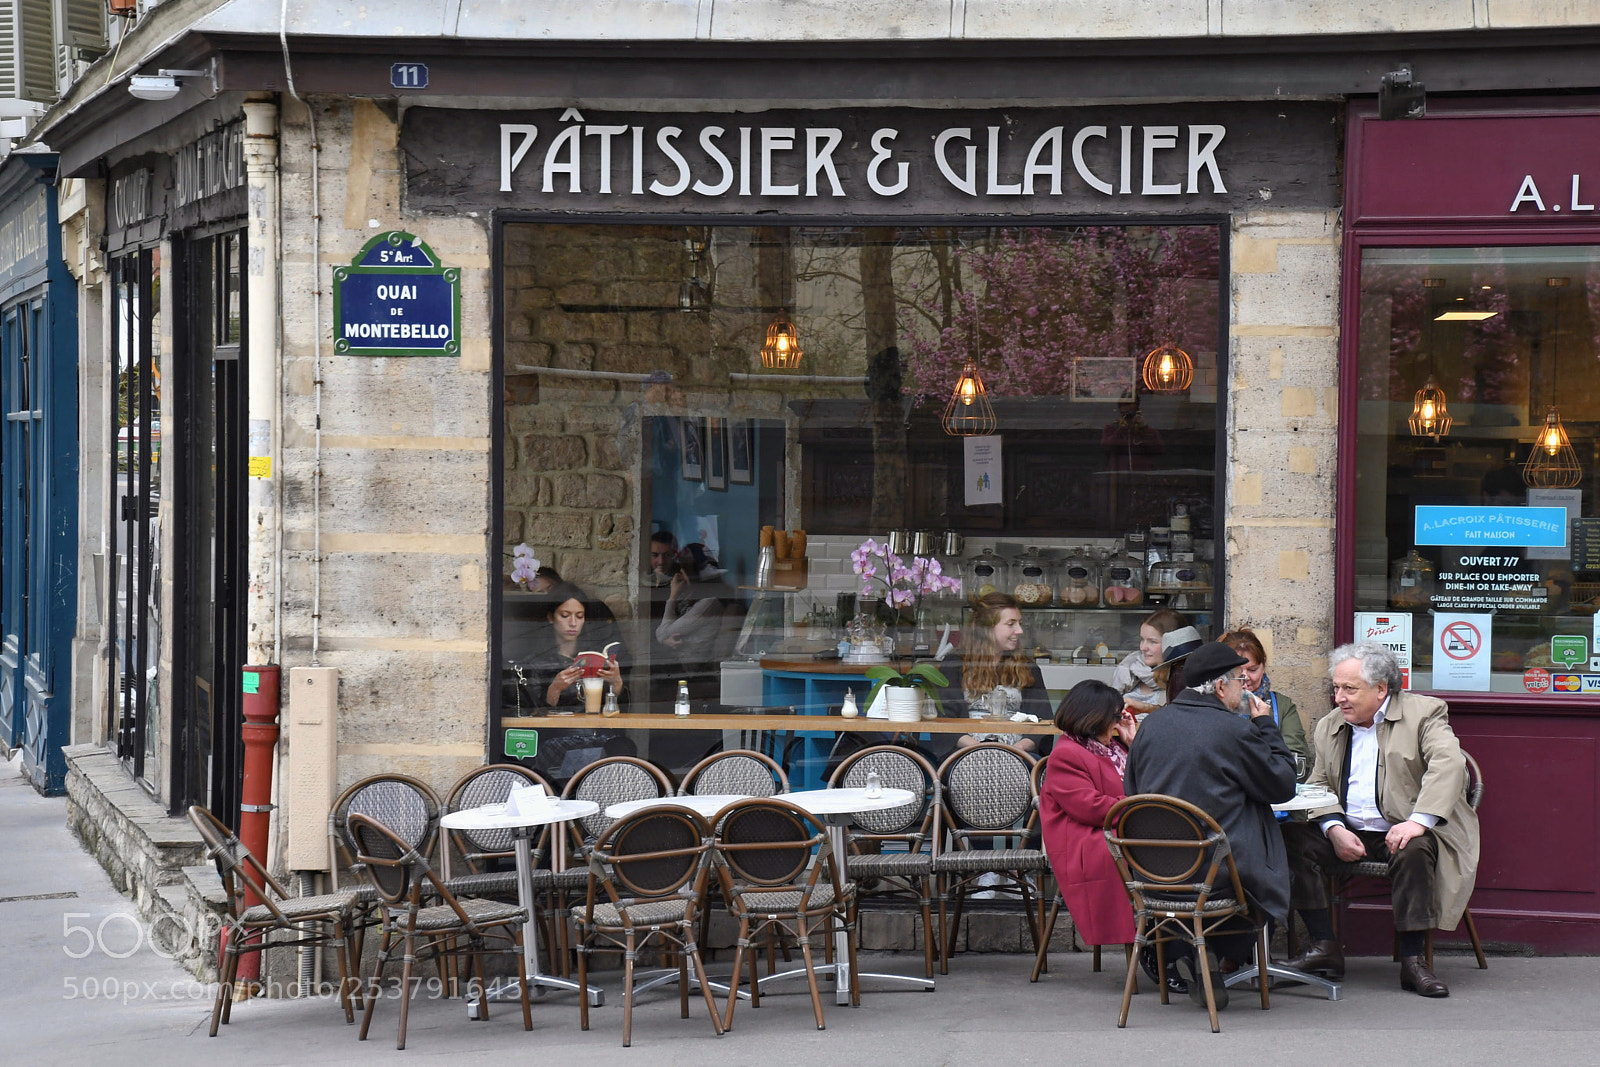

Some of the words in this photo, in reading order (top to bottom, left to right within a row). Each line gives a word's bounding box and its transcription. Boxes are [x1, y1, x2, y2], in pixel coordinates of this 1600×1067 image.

[397, 65, 419, 86] 11
[499, 107, 847, 197] PÂTISSIER
[866, 127, 910, 197] &
[933, 124, 1229, 197] GLACIER
[376, 284, 418, 300] QUAI
[390, 307, 404, 316] DE
[344, 323, 450, 339] MONTEBELLO
[1423, 515, 1486, 532] A.LACROIX
[1488, 512, 1560, 533] PÂTISSERIE
[1464, 531, 1482, 539] FAIT
[1483, 531, 1516, 539] MAISON
[1459, 556, 1502, 567] OUVERT
[1503, 556, 1520, 568] 7/7
[1438, 572, 1454, 581] SUR
[1455, 572, 1481, 581] PLACE
[1482, 573, 1496, 581] OU
[1497, 573, 1540, 582] EMPORTER
[1445, 582, 1476, 591] DINE-IN
[1477, 583, 1490, 591] OR
[1491, 583, 1533, 592] TAKE-AWAY
